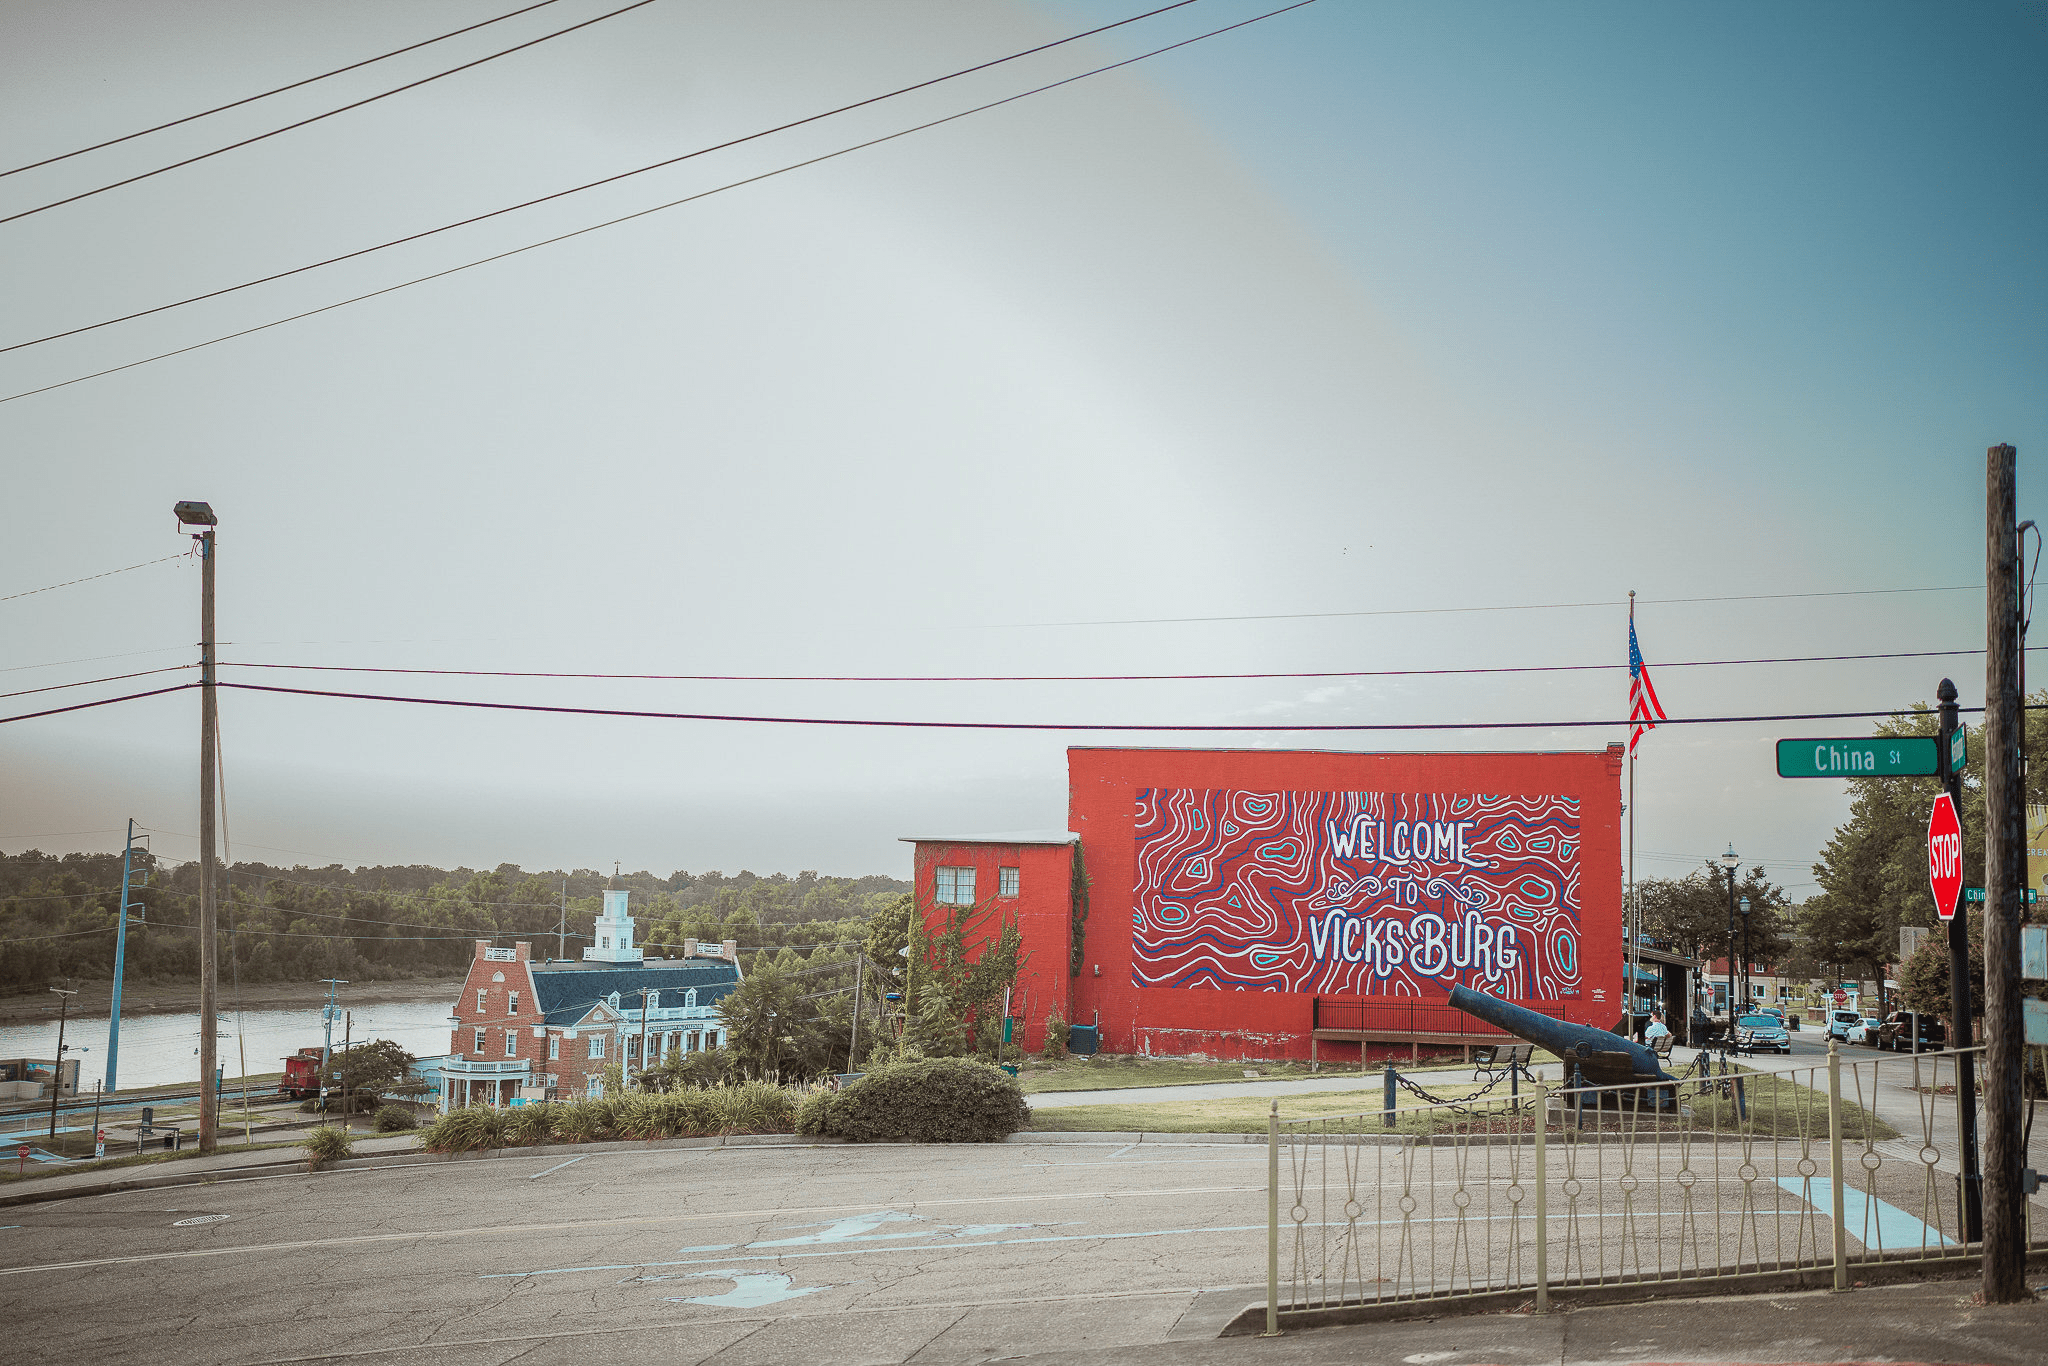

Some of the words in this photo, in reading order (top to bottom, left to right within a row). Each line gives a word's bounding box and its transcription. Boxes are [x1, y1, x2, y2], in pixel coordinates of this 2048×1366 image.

[1815, 744, 1875, 771] China
[1889, 750, 1901, 764] St
[1329, 814, 1489, 867] WELCOME
[1931, 833, 1959, 879] STOP
[2026, 848, 2048, 856] CREA
[1388, 873, 1418, 904] TO
[1967, 889, 1986, 900] Chin
[1310, 908, 1518, 982] VICKSBURG
